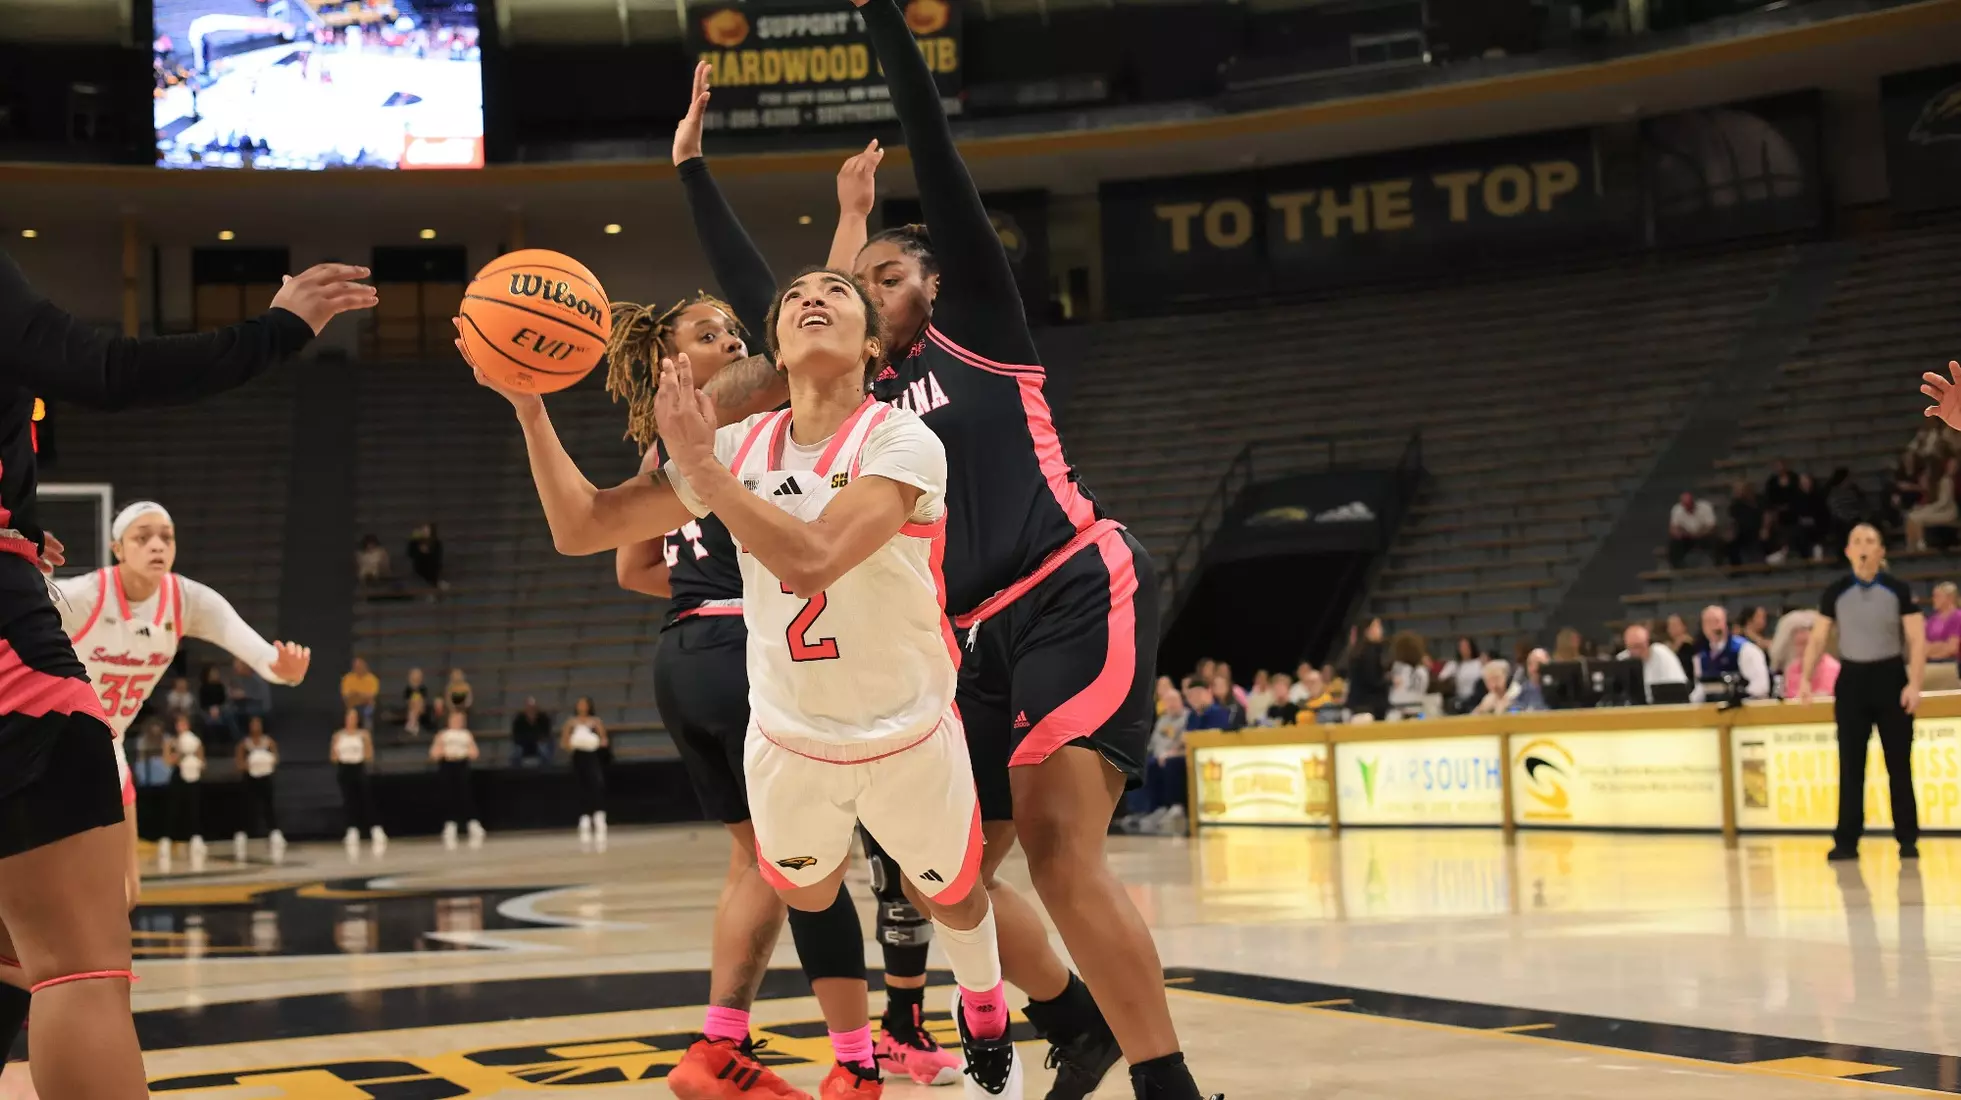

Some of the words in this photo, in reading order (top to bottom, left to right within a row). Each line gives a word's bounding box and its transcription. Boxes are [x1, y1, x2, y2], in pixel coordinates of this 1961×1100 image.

[756, 13, 848, 39] SUPPORT
[700, 44, 869, 88] HARDWOOD
[1154, 198, 1253, 252] TO
[1267, 179, 1414, 242] THE
[1432, 160, 1579, 222] TOP
[509, 272, 604, 329] Wilson
[100, 672, 155, 717] 35
